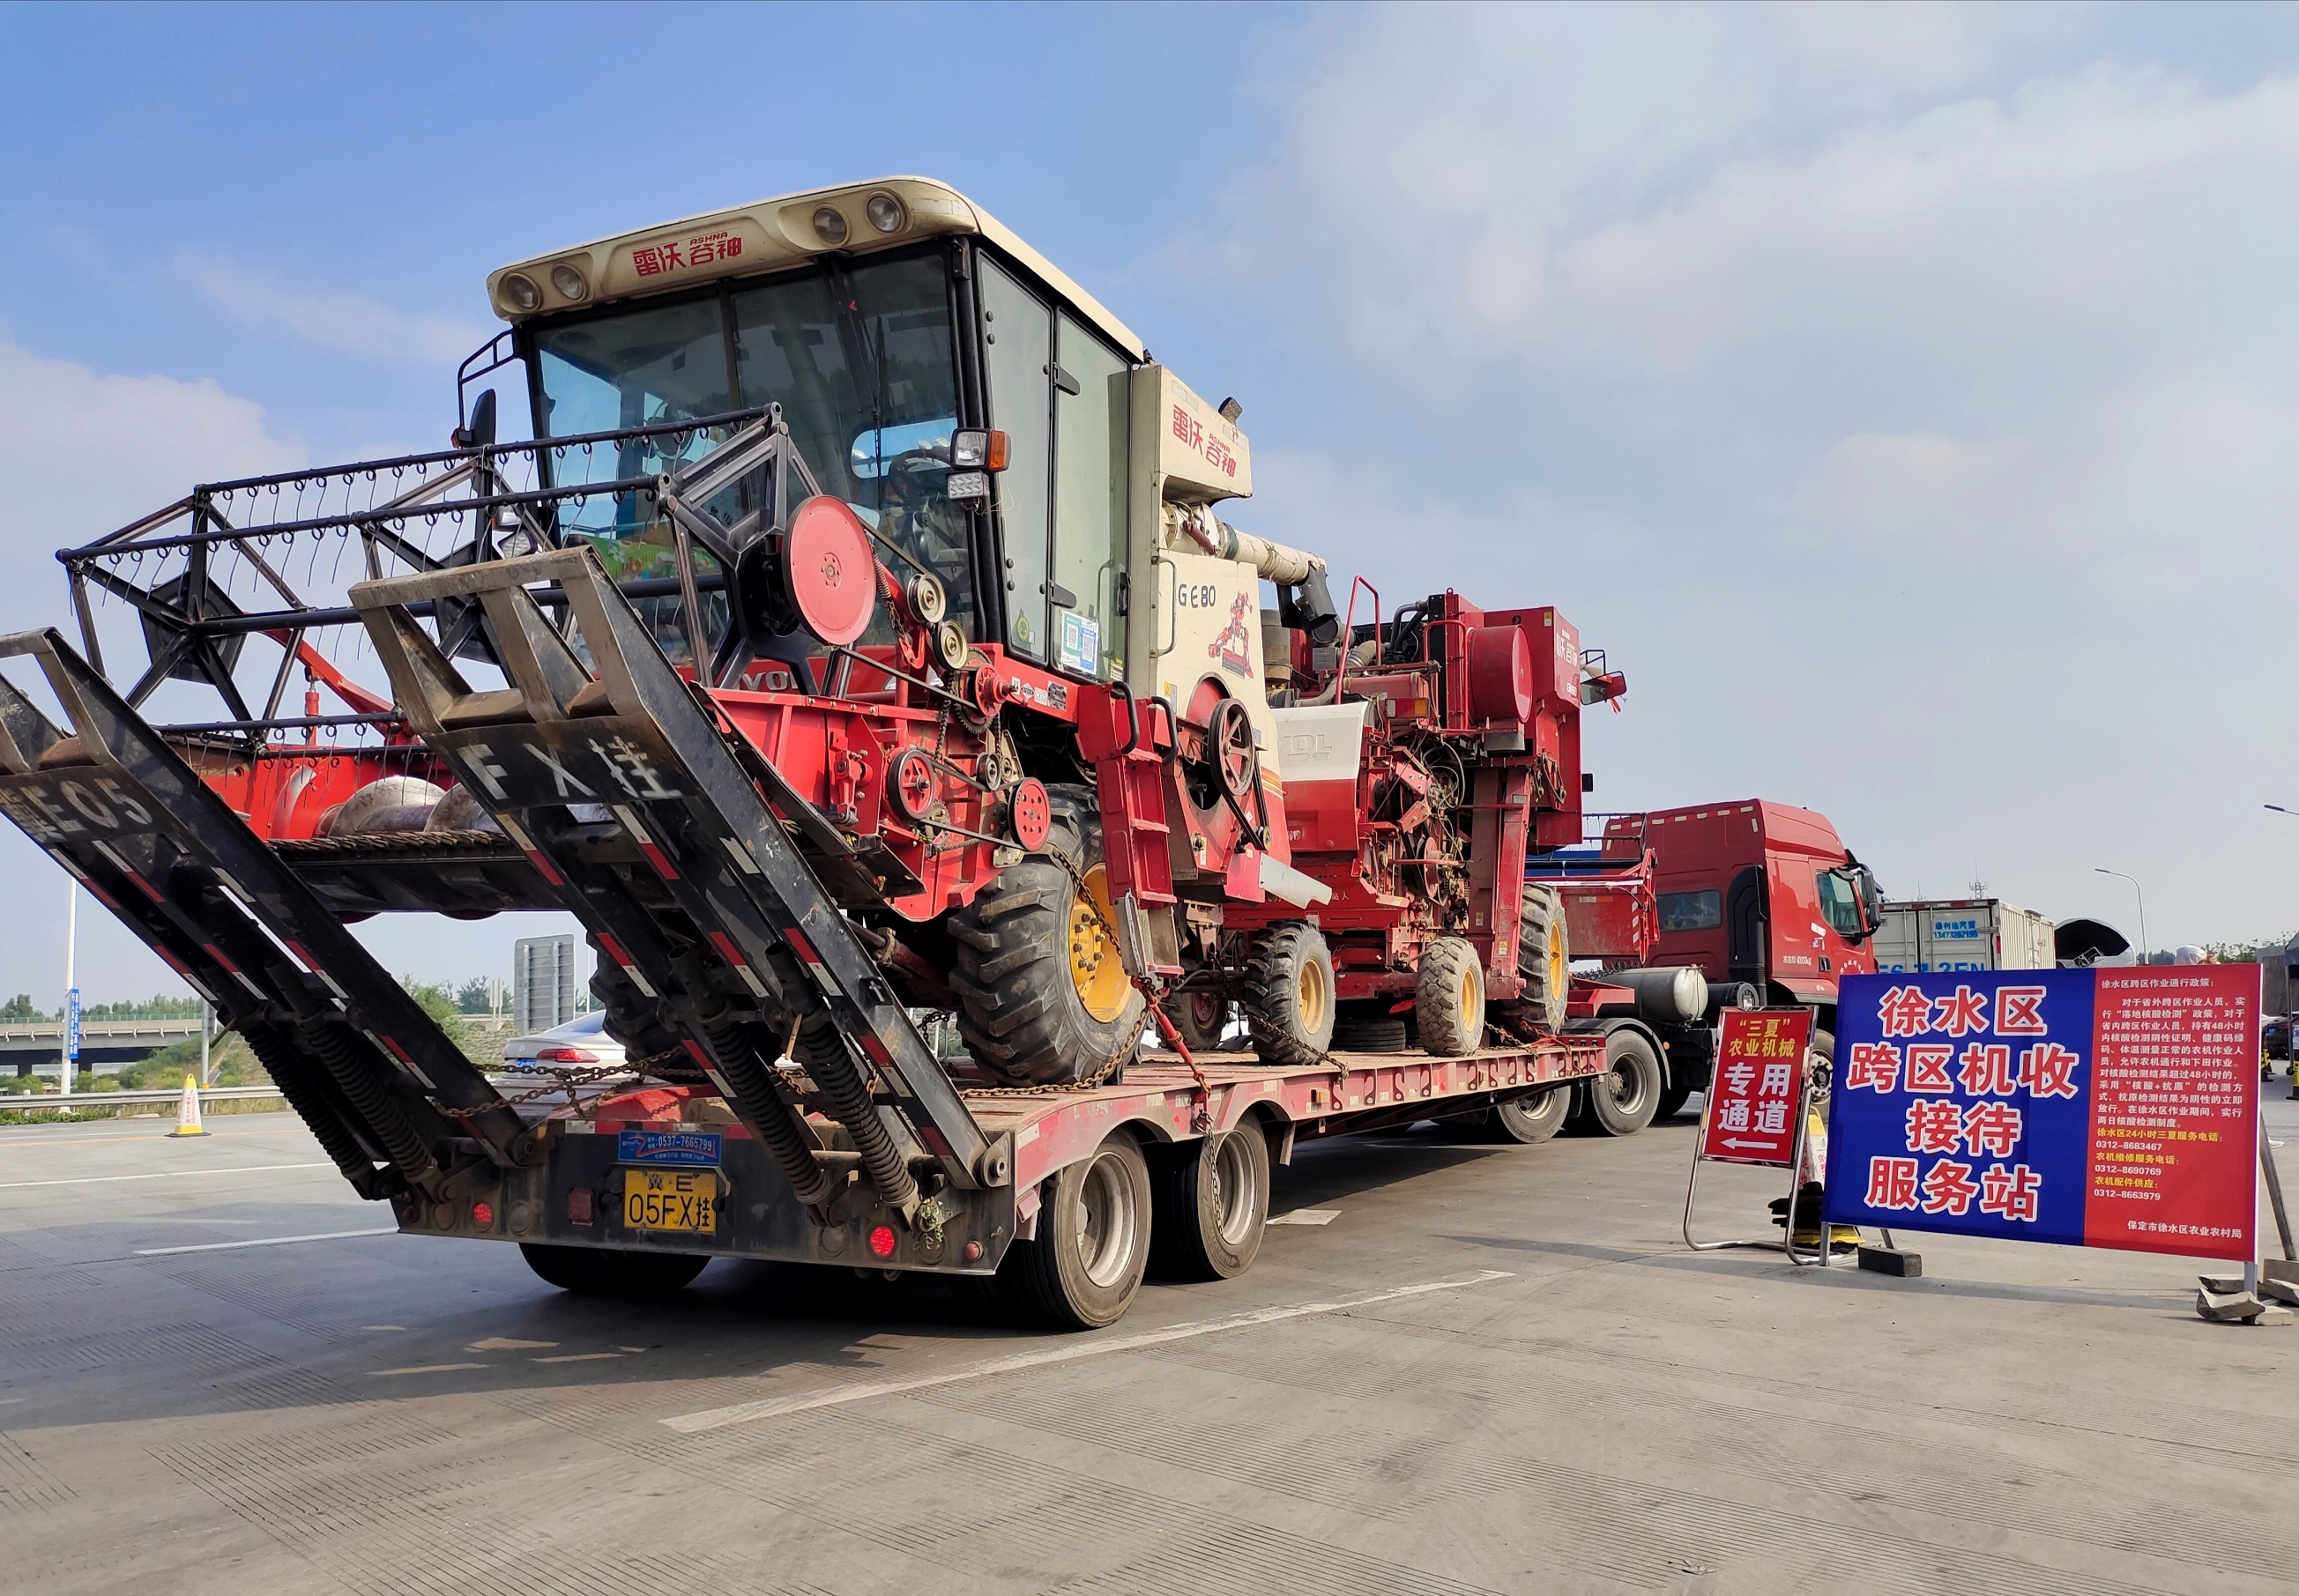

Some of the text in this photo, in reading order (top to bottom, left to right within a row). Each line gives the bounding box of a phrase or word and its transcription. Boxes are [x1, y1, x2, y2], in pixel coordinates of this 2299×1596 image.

[690, 232, 727, 246] ASHNA
[1209, 433, 1231, 454] ASHNA
[1179, 583, 1216, 609] GE80
[1878, 985, 2047, 1037] 徐水区
[1728, 1038, 1796, 1058] 农业机械
[1724, 1061, 1792, 1097] 专用
[1846, 1041, 2080, 1099] 跨区机收
[1717, 1099, 1789, 1134] 通道
[1906, 1098, 2022, 1158] 接待
[2095, 1140, 2162, 1151] 0312-8683467
[2094, 1165, 2161, 1177] 0312-8690769
[1864, 1155, 2042, 1222] 服务站
[2094, 1189, 2161, 1201] 0312-8663979
[629, 1193, 711, 1227] 05FX挂
[2127, 1220, 2242, 1239] 保定市徐水区农业农村局
